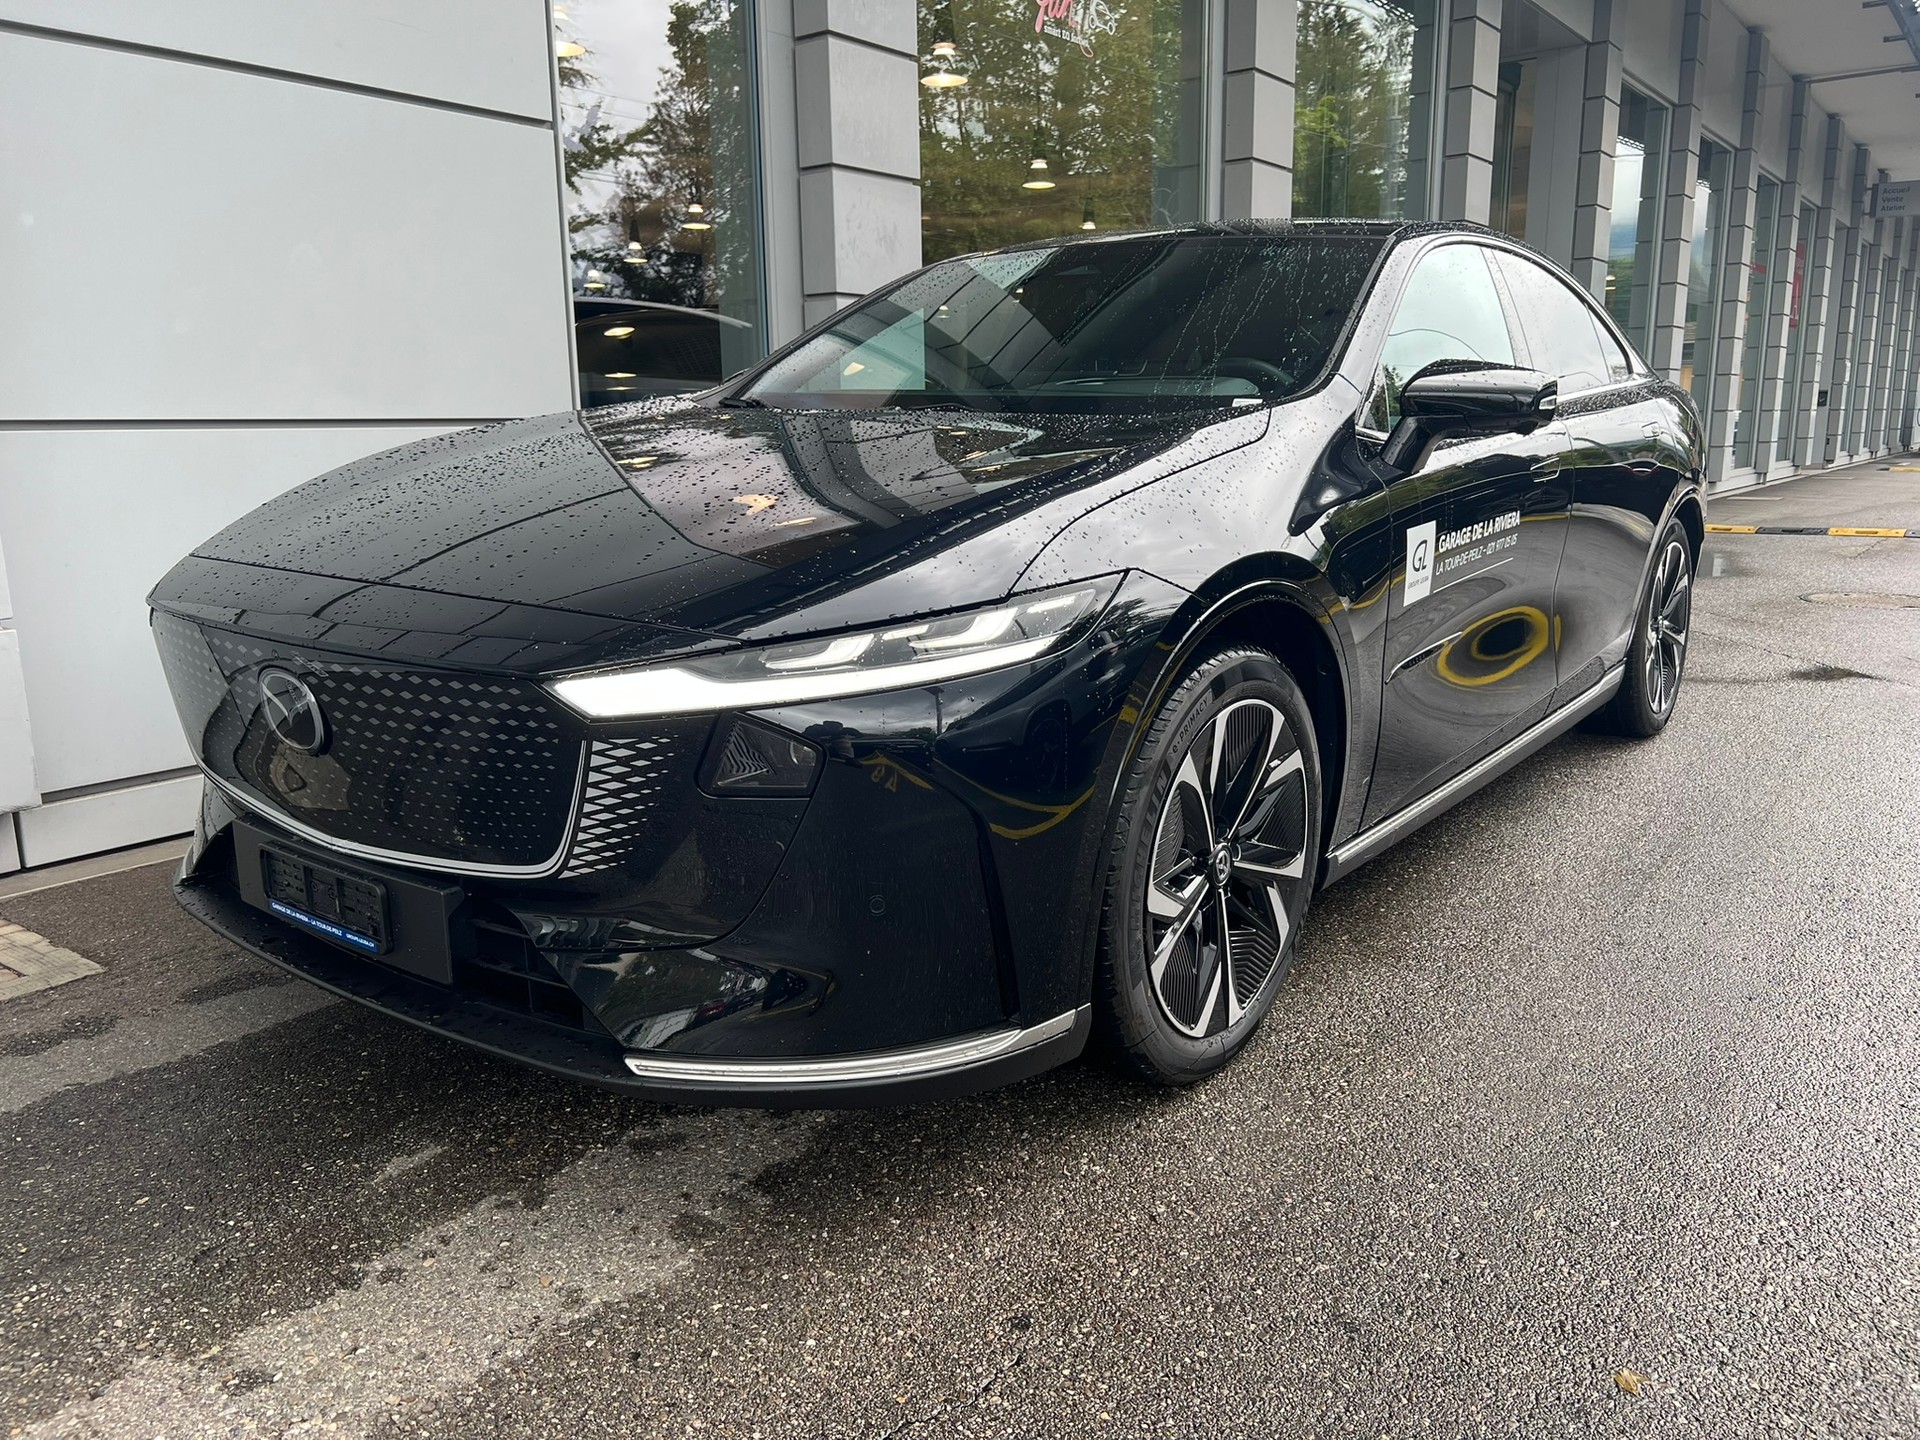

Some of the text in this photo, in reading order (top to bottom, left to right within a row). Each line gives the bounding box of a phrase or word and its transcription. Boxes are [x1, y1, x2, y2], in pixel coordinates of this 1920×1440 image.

[1883, 186, 1911, 194] Accueil
[1439, 510, 1521, 553] GARAGE DE LA RIVIERA
[1435, 561, 1444, 576] LA
